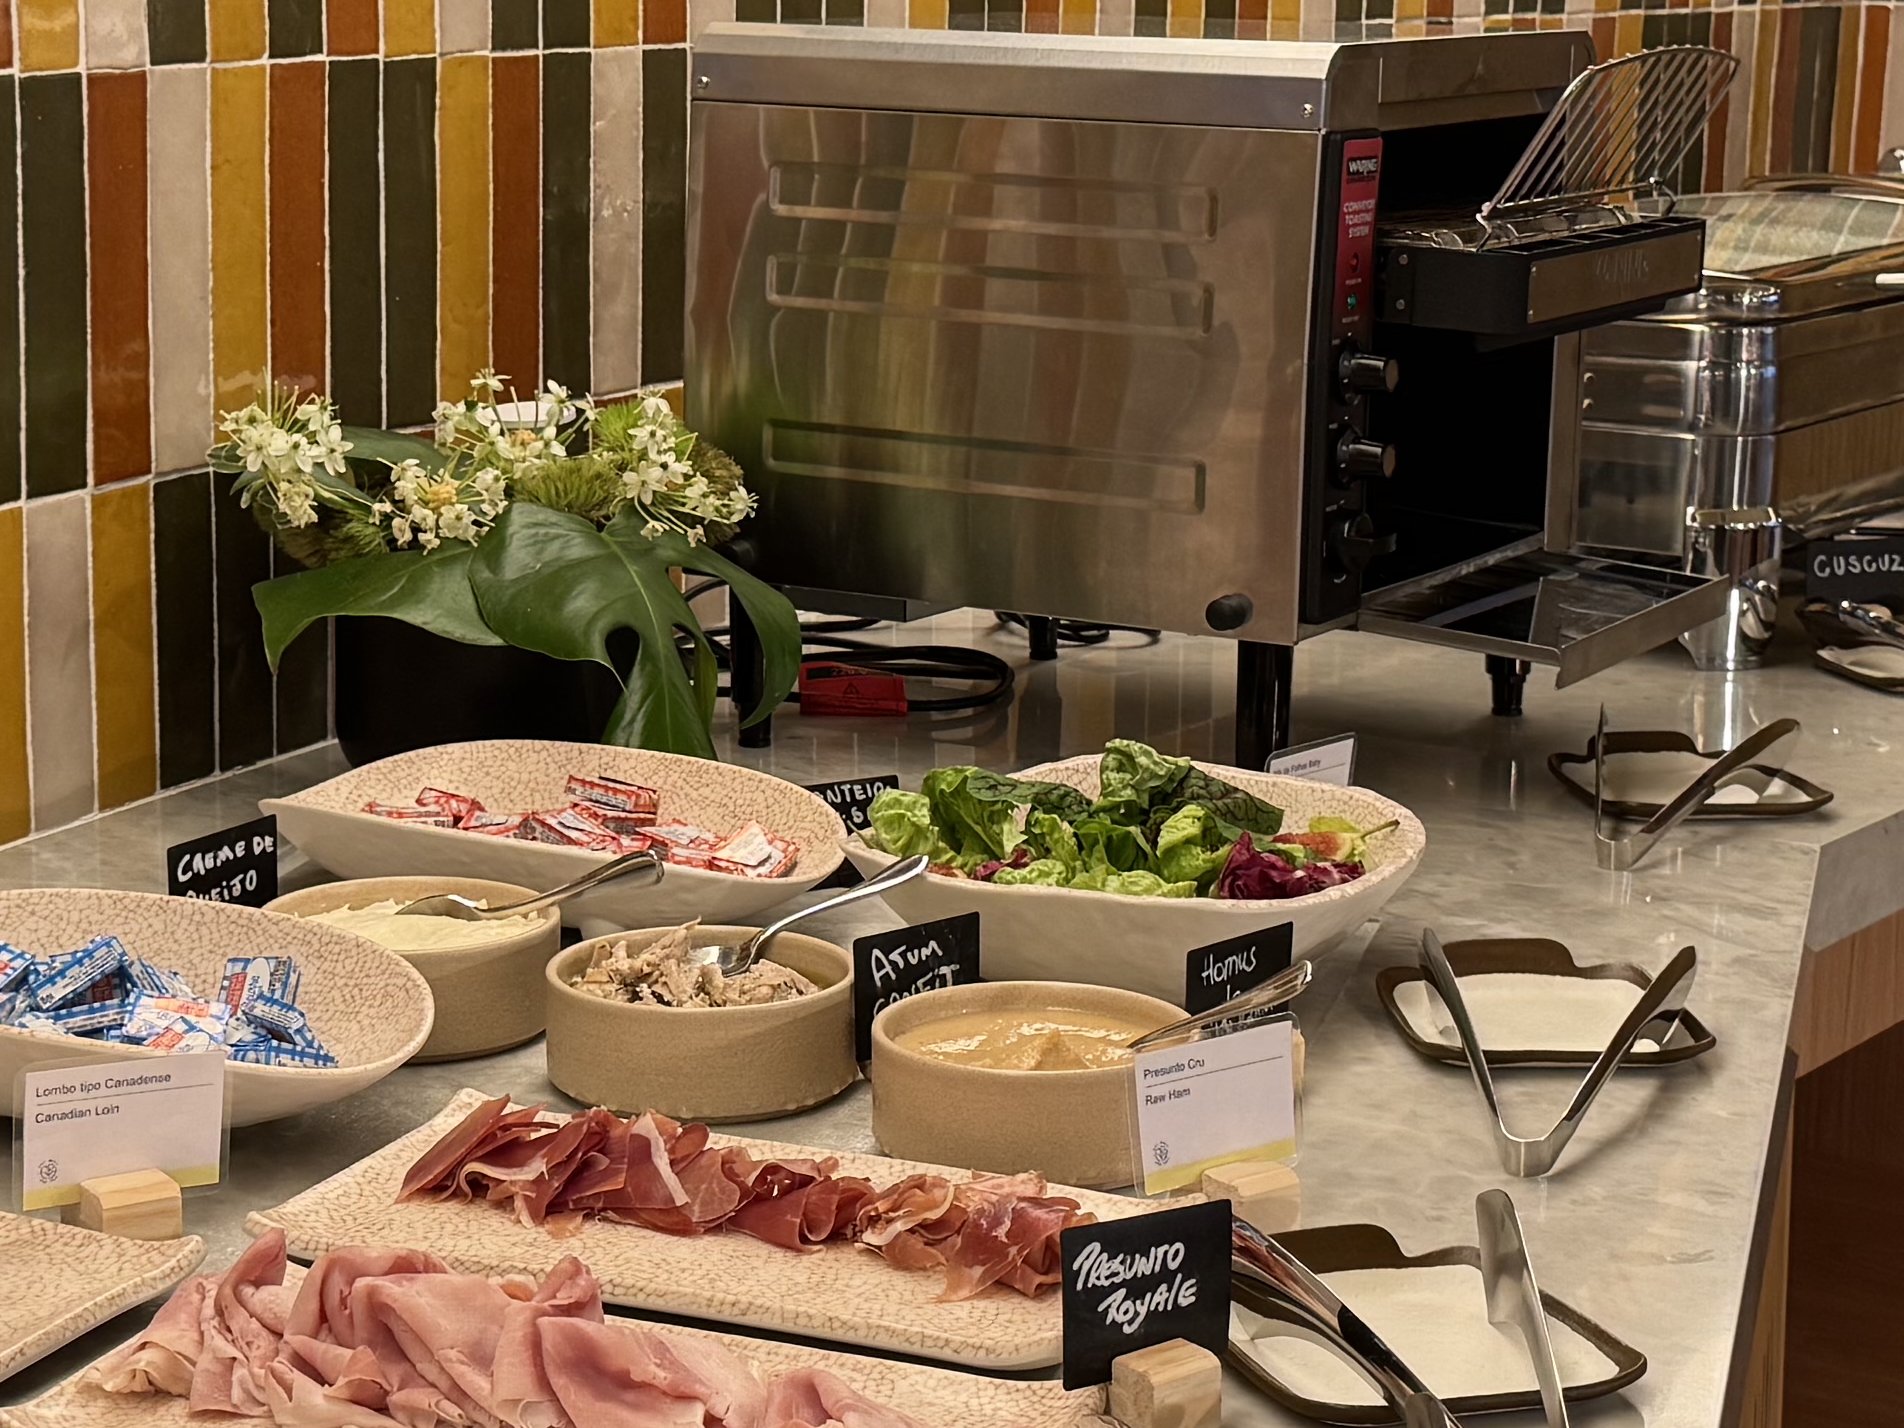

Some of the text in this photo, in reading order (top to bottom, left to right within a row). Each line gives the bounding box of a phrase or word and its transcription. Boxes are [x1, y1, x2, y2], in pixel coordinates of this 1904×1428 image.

[252, 834, 275, 856] DE
[871, 939, 944, 988] ATUM
[1143, 1061, 1186, 1081] Presunto
[35, 1072, 172, 1098] Lombo tipo Canadense
[1145, 1087, 1192, 1107] Raw Ham
[35, 1103, 120, 1124] Canadian Loin
